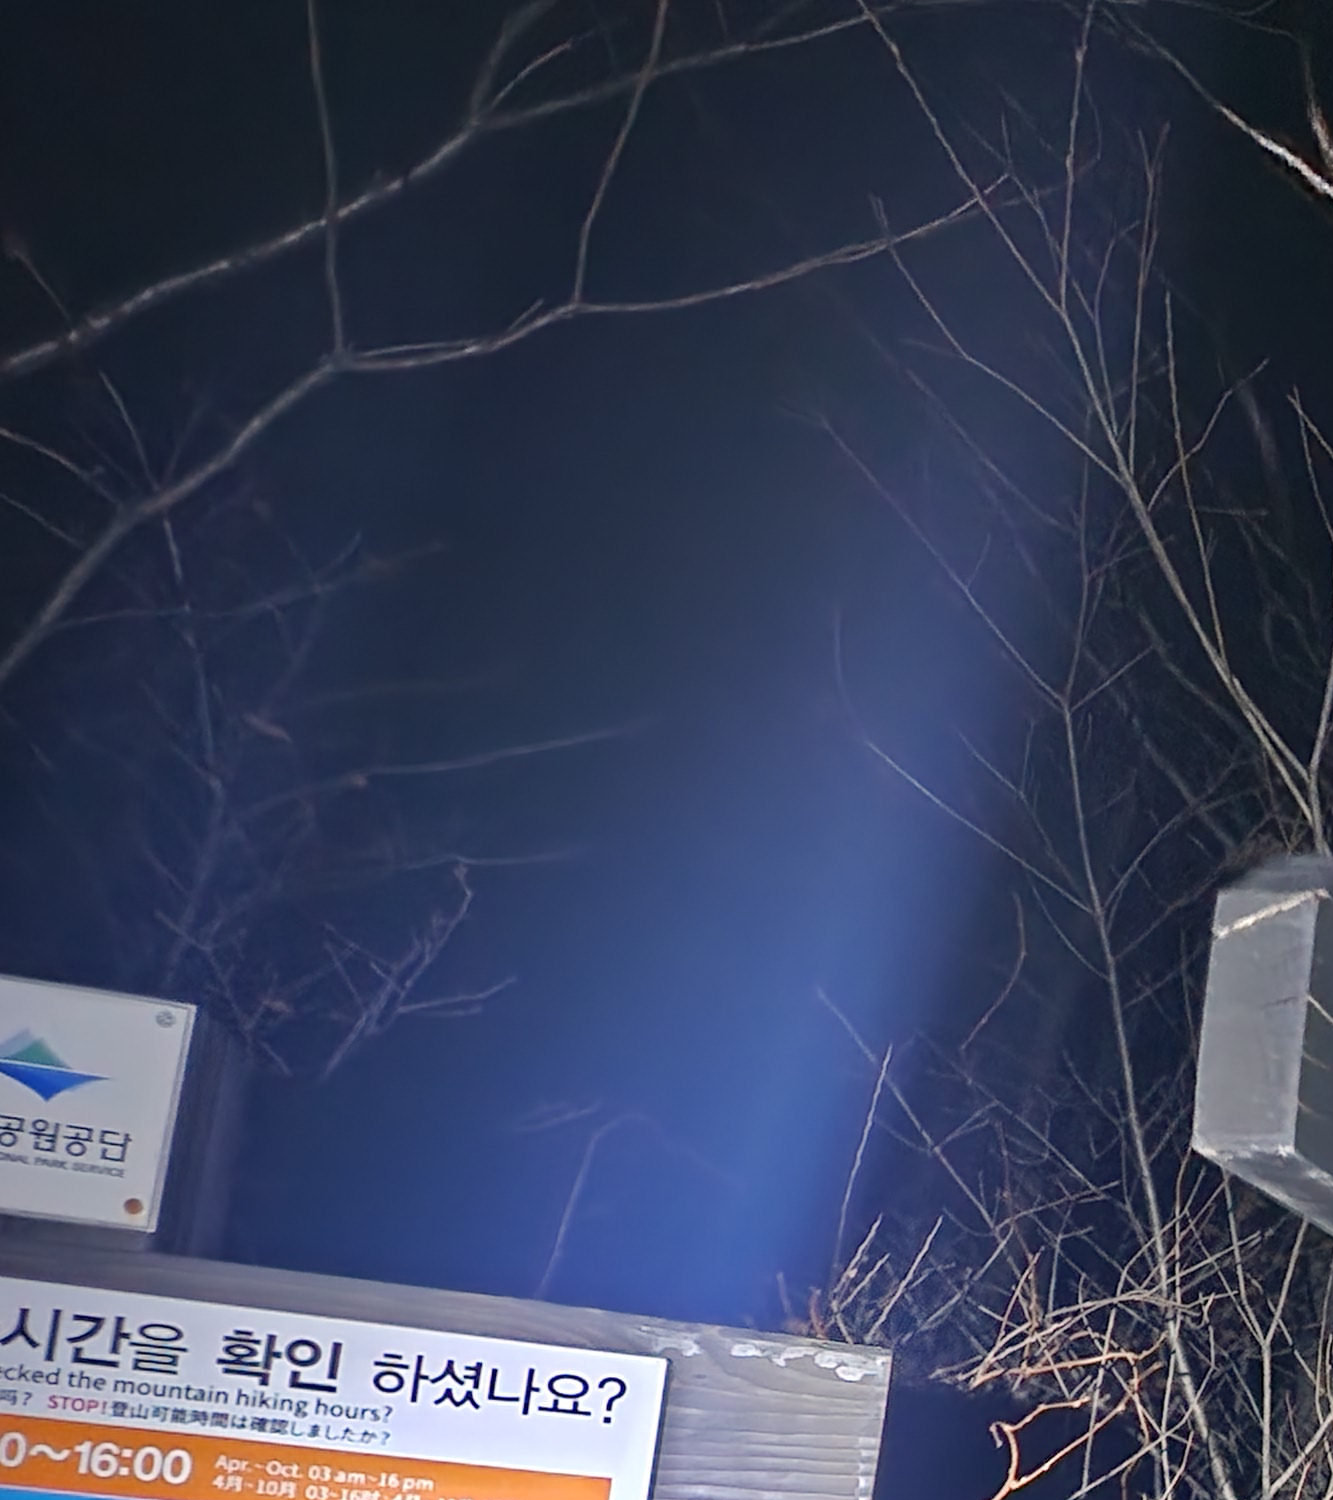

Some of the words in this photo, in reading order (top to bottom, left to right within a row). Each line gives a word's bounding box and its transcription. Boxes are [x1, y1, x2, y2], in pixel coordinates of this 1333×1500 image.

[0, 1307, 189, 1376] 시간을
[215, 1329, 343, 1394] 확인
[372, 1352, 628, 1424] 하셨나요?
[68, 1369, 107, 1391] the
[113, 1379, 229, 1404] mountain
[235, 1387, 308, 1418] hiking
[314, 1397, 393, 1423] hours?
[402, 1476, 435, 1492] pm
